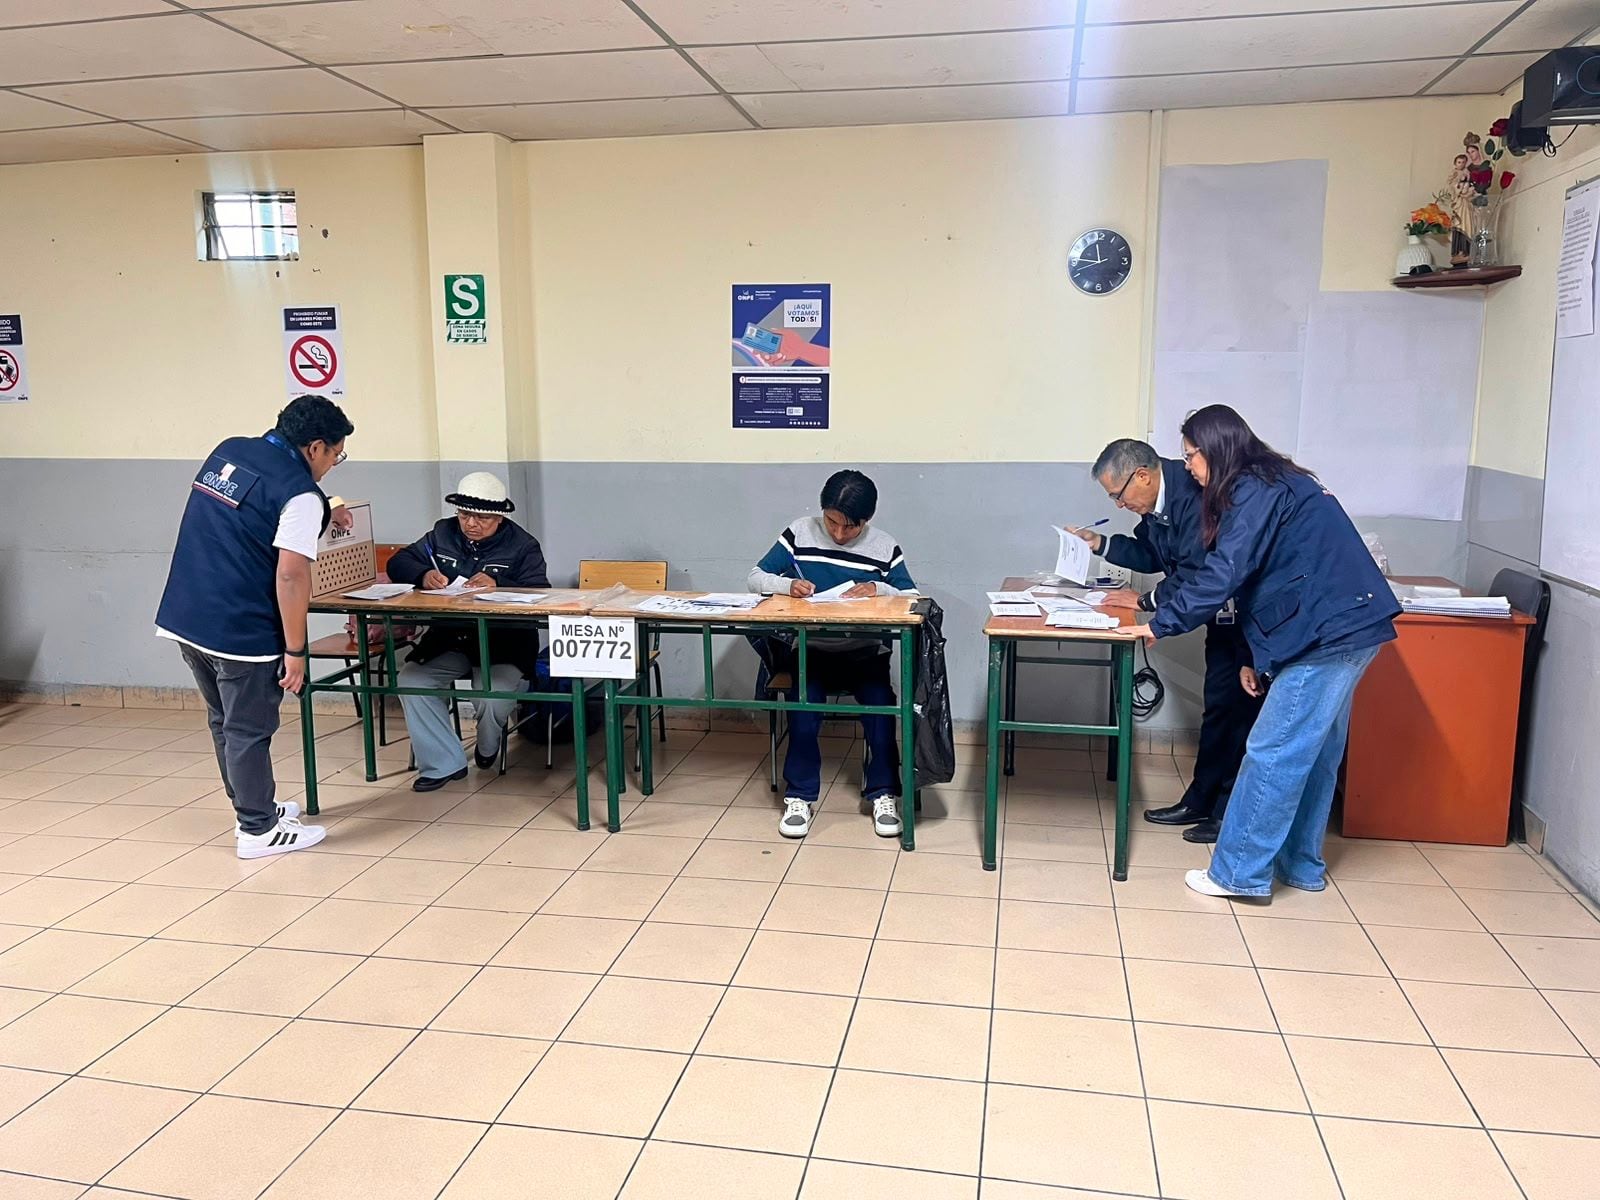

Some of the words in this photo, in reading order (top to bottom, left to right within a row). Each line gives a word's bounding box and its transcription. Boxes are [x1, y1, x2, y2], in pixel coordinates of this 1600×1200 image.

[1121, 257, 1129, 265] 3
[1095, 283, 1102, 291] 6
[451, 277, 480, 317] S
[203, 471, 238, 496] ONPE
[331, 528, 351, 539] ONPE
[561, 624, 604, 637] MESA
[552, 639, 632, 660] 007772
